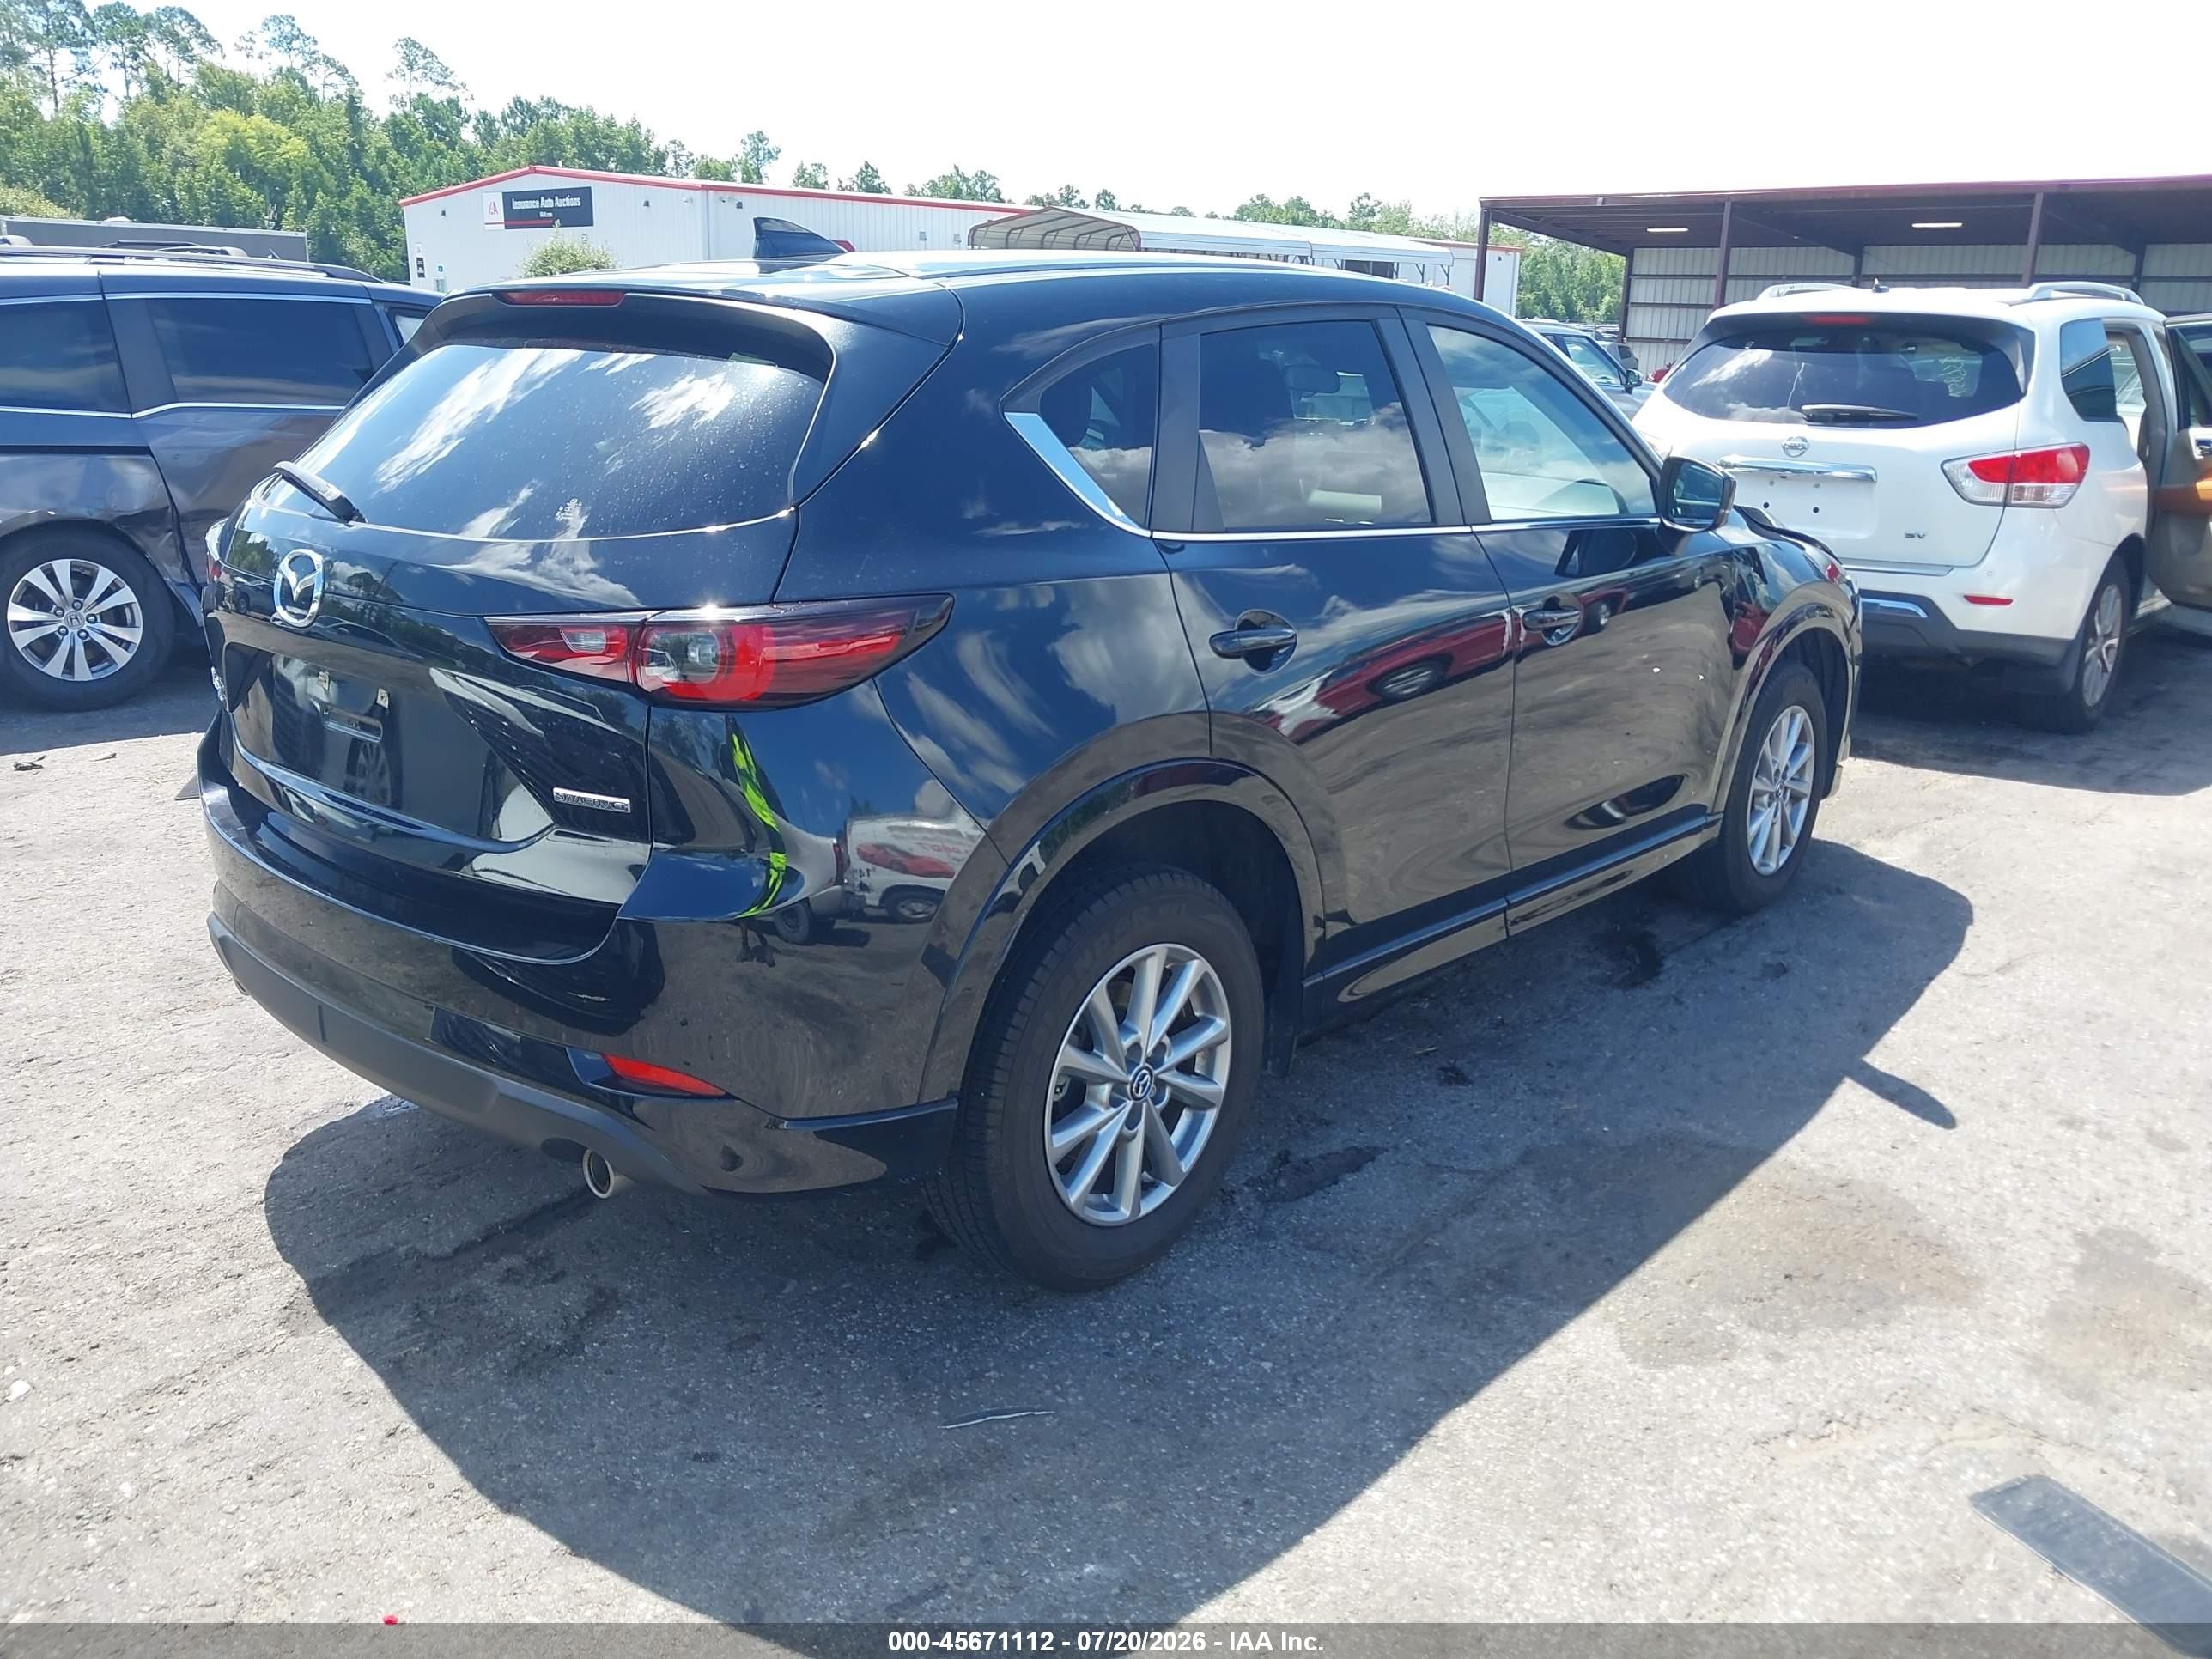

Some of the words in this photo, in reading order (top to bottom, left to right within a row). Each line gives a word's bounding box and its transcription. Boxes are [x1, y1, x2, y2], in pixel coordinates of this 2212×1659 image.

[512, 198, 539, 210] Insurance
[540, 196, 554, 208] Auto
[555, 194, 581, 207] Auctions
